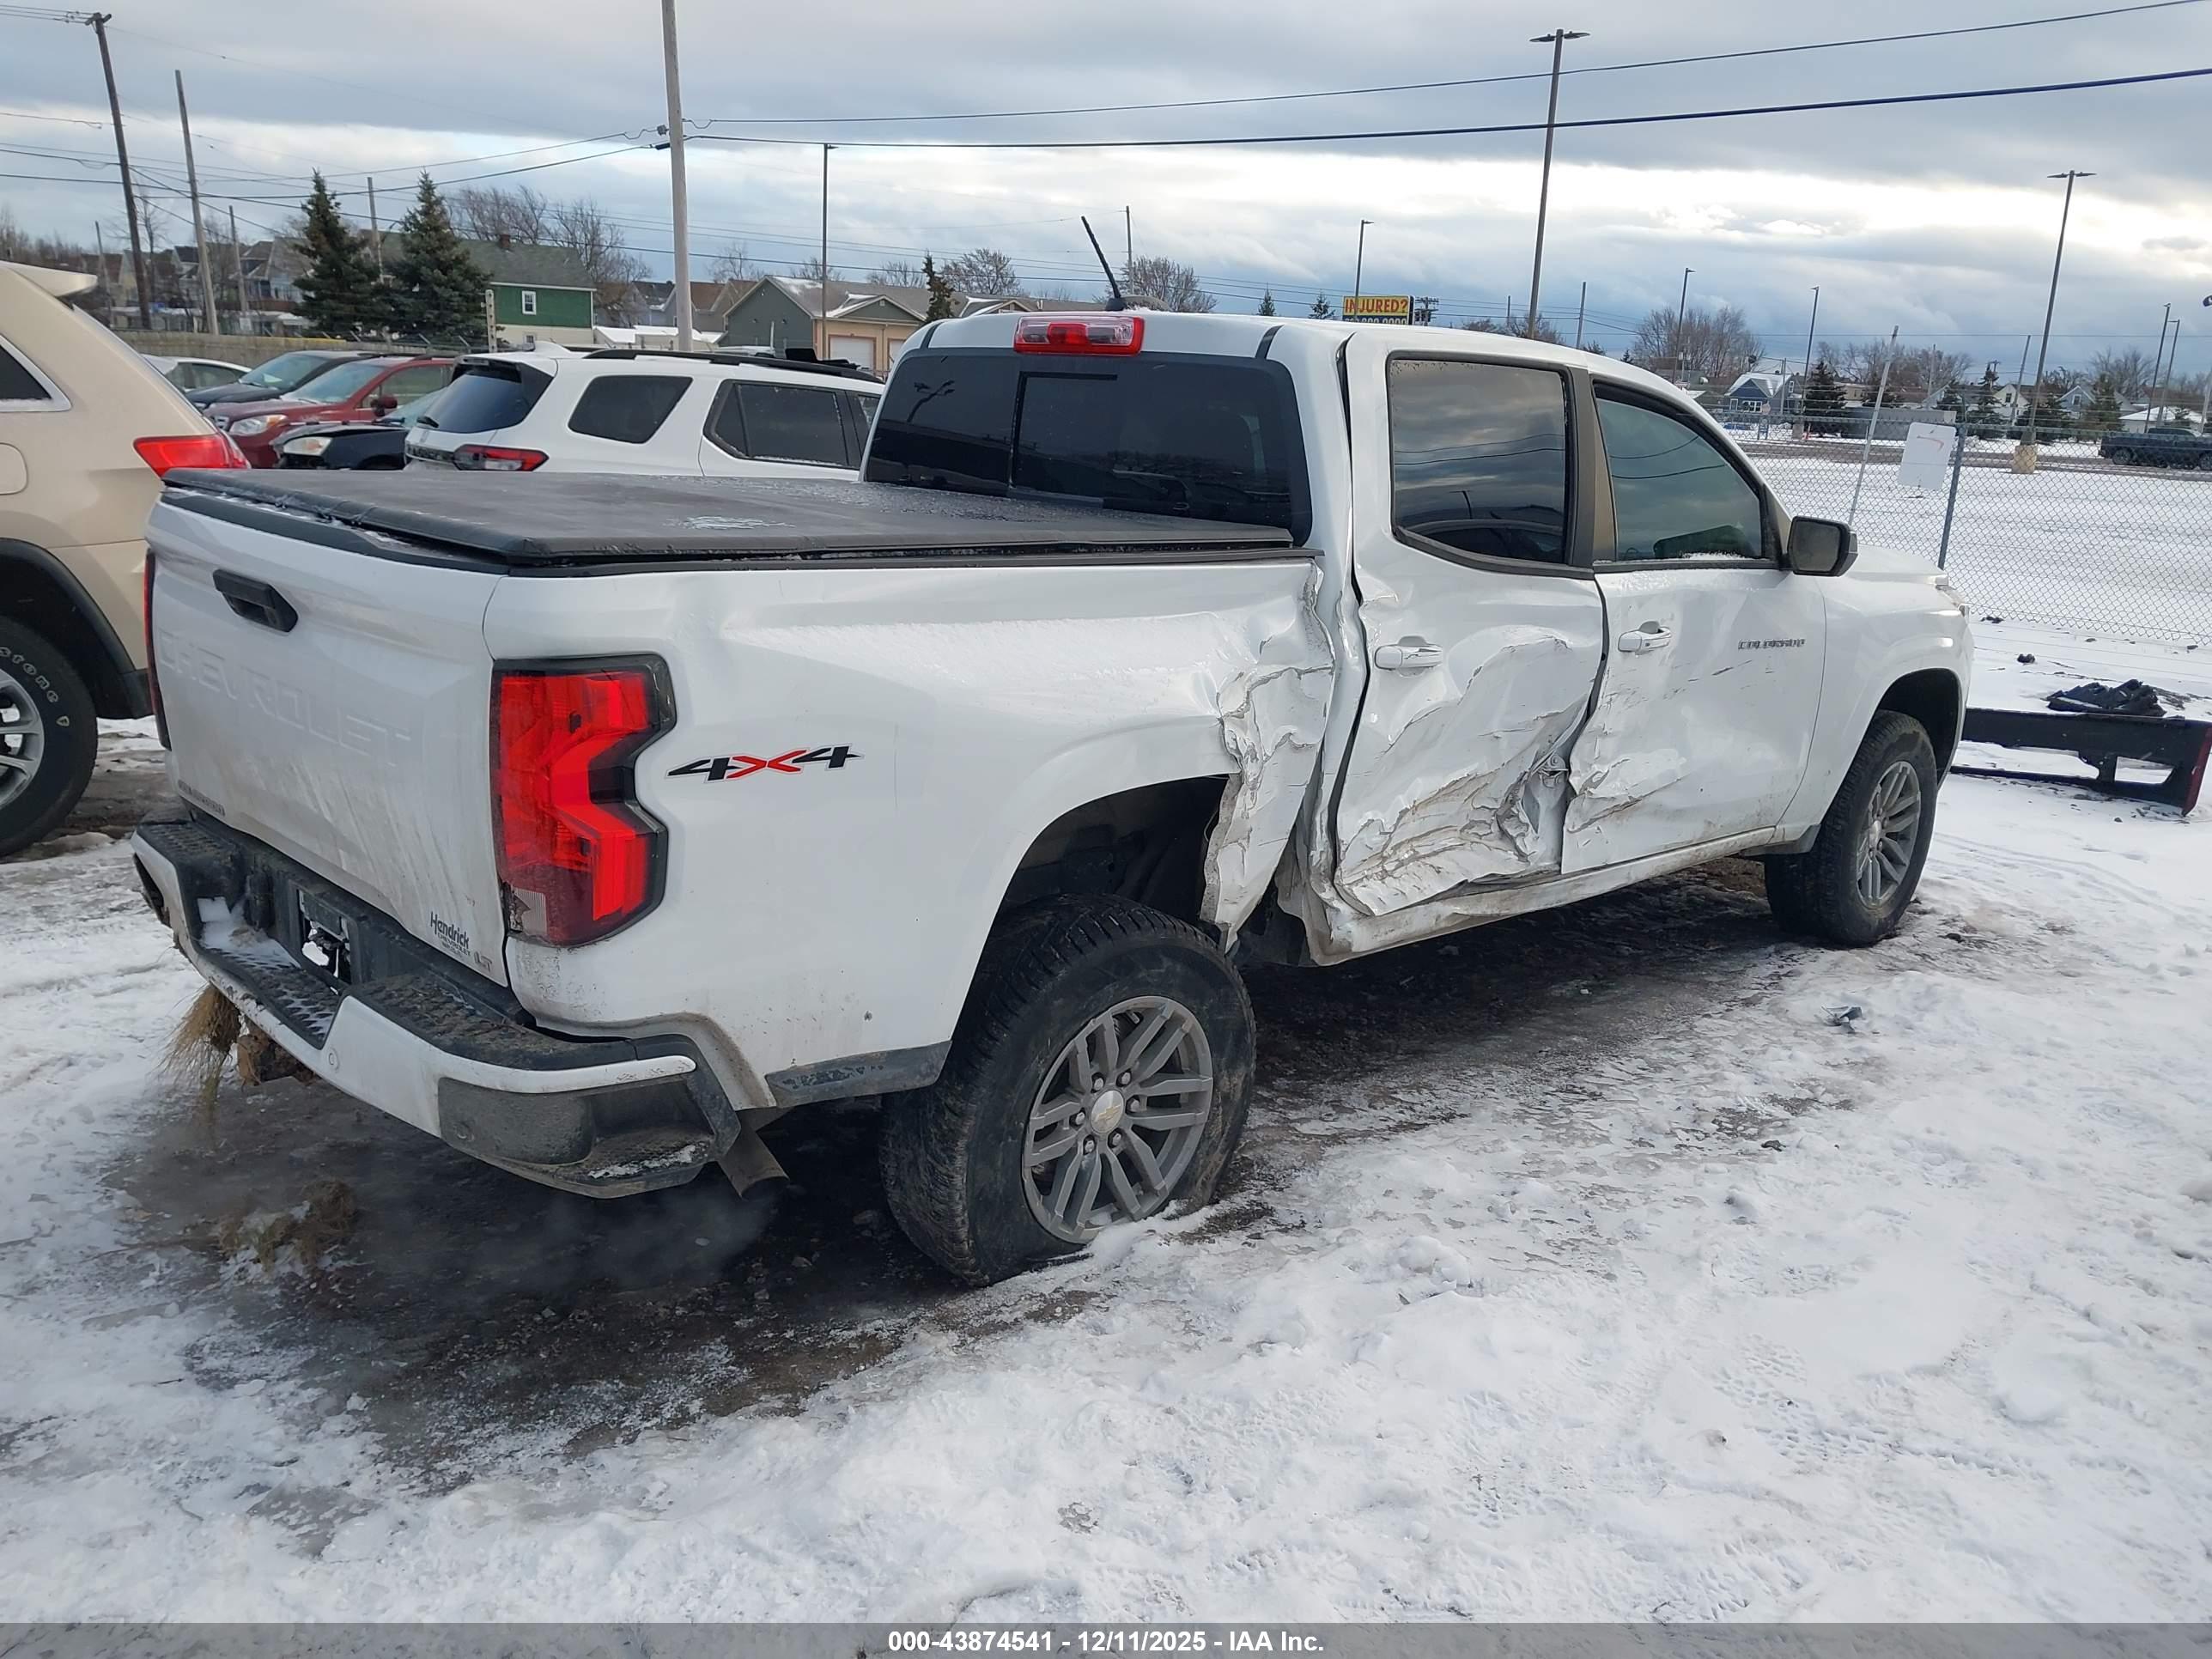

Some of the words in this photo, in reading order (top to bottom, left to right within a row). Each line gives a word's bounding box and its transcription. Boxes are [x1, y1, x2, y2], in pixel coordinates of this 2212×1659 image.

[1345, 298, 1408, 313] INJURED?
[158, 627, 412, 768] CHEVROLET
[430, 911, 470, 950] Hendrick
